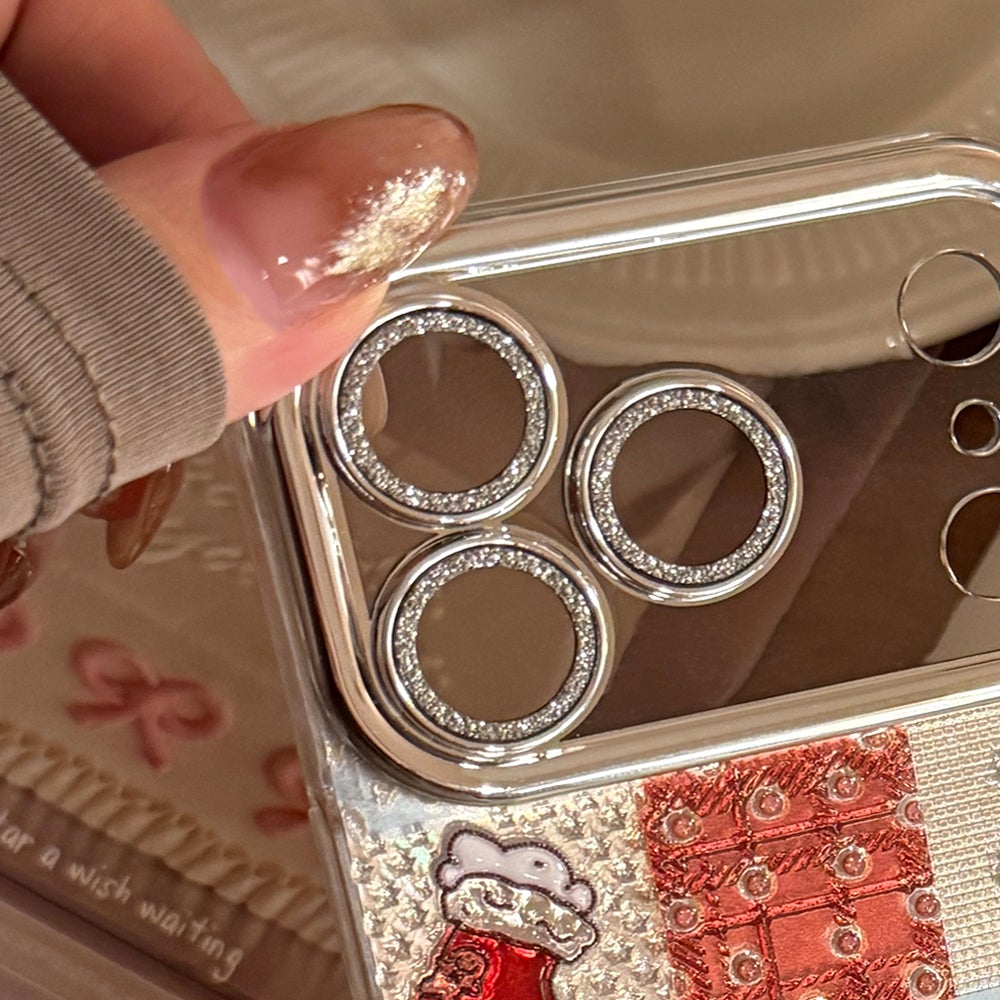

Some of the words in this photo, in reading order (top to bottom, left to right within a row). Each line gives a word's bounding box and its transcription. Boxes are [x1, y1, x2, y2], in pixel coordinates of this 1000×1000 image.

[40, 846, 62, 871] a
[69, 861, 131, 903] wish
[139, 901, 245, 983] waiting
